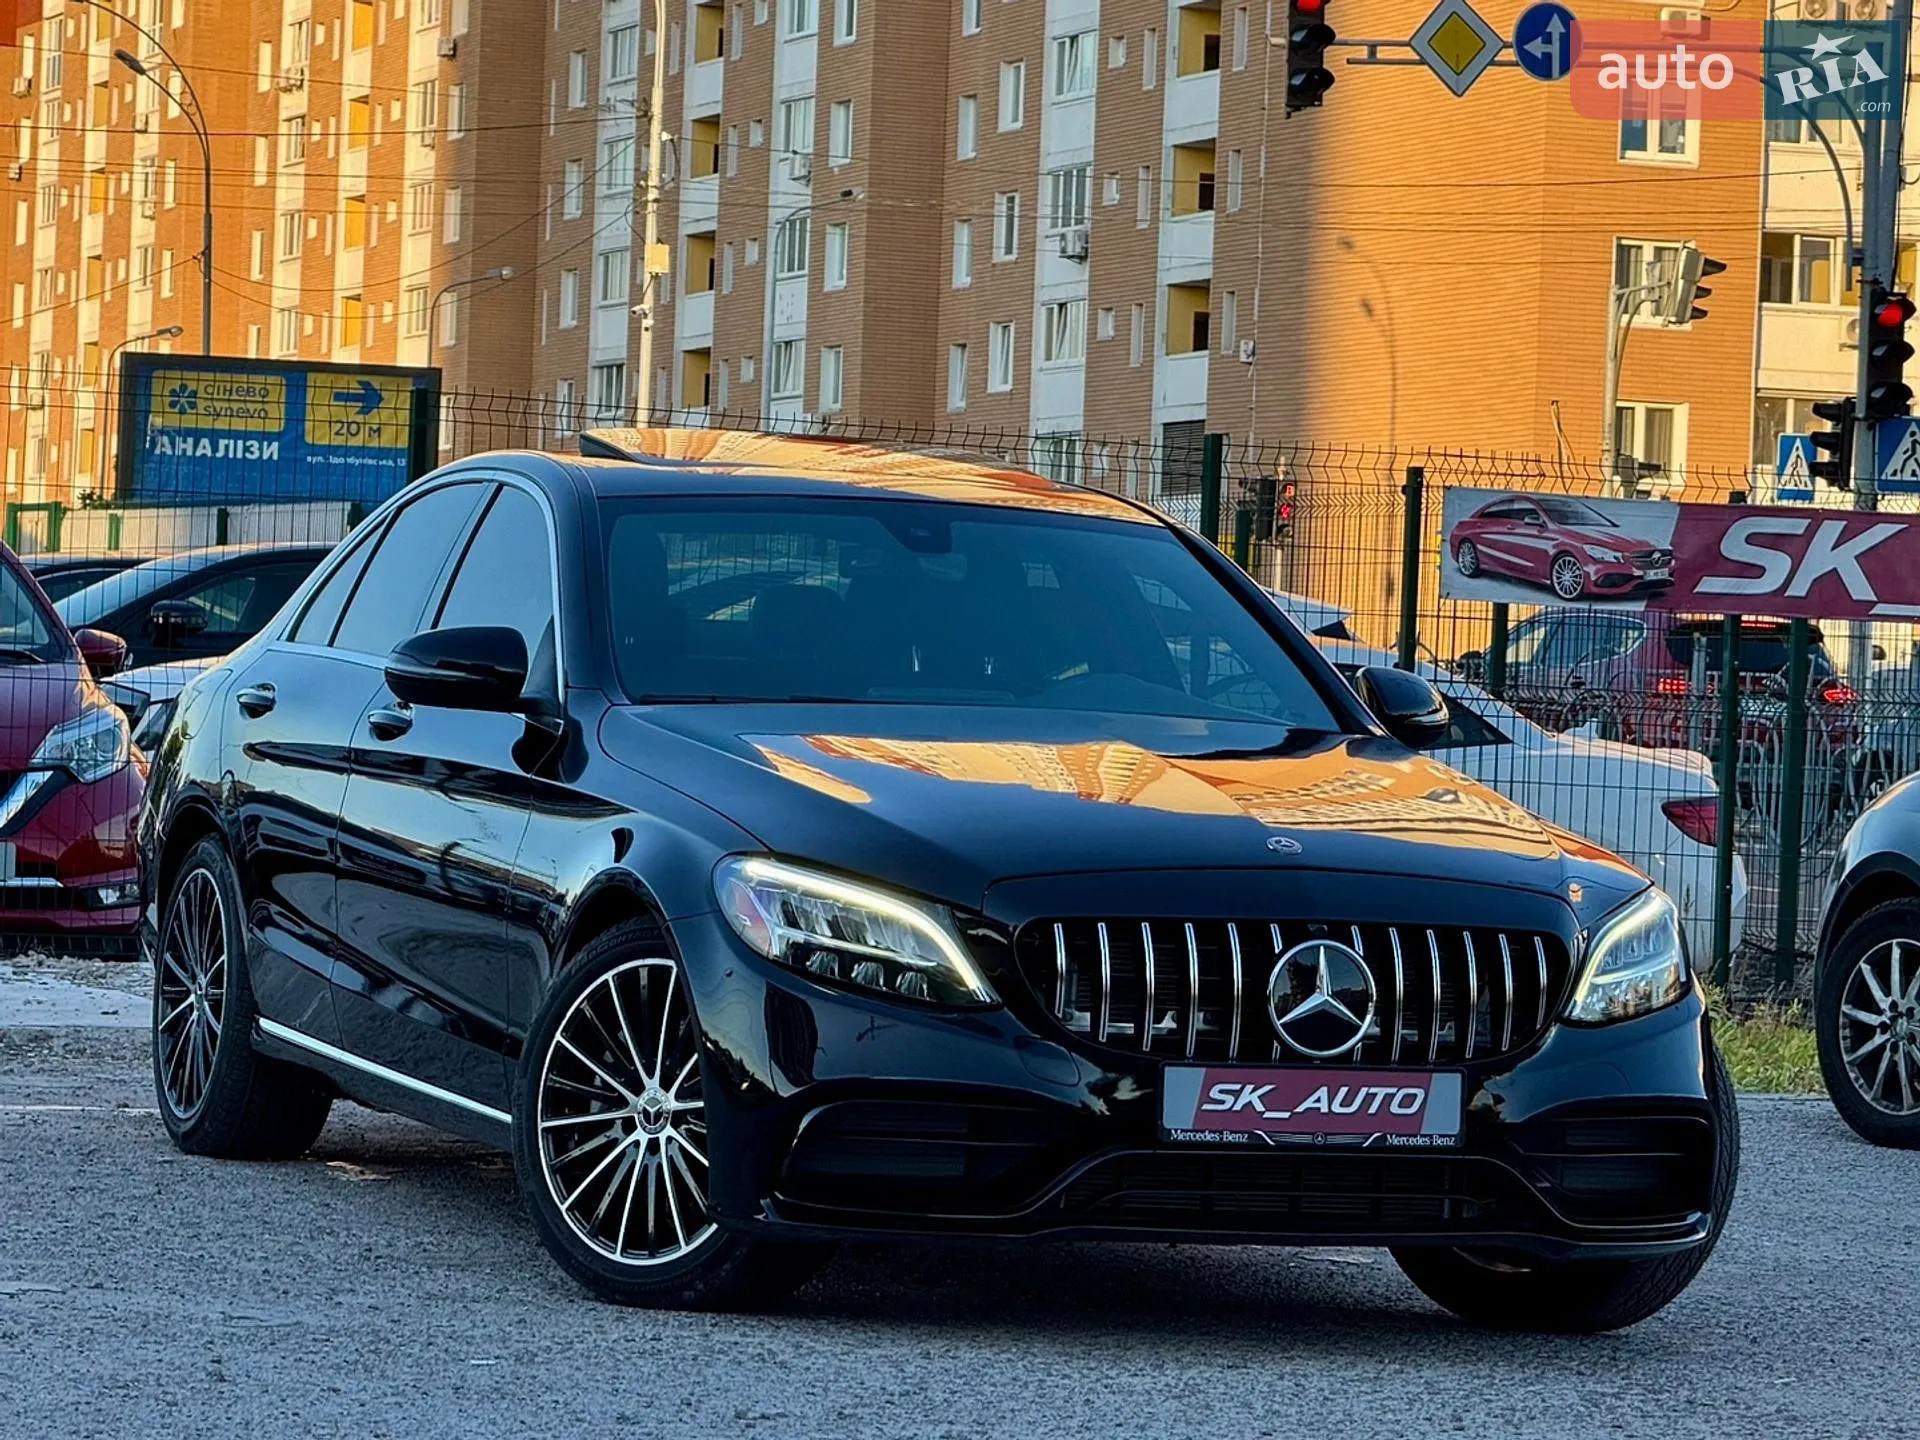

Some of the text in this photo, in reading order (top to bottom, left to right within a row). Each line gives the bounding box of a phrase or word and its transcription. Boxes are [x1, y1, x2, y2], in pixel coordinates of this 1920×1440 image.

[203, 382, 270, 398] сінево
[203, 403, 269, 420] synevo
[333, 420, 360, 438] 20
[153, 436, 279, 461] АНАЛІЗИ
[1200, 1083, 1426, 1119] SK_AUTO
[1170, 1129, 1456, 1146] Mercedes-Benz Mercedes-Benz
